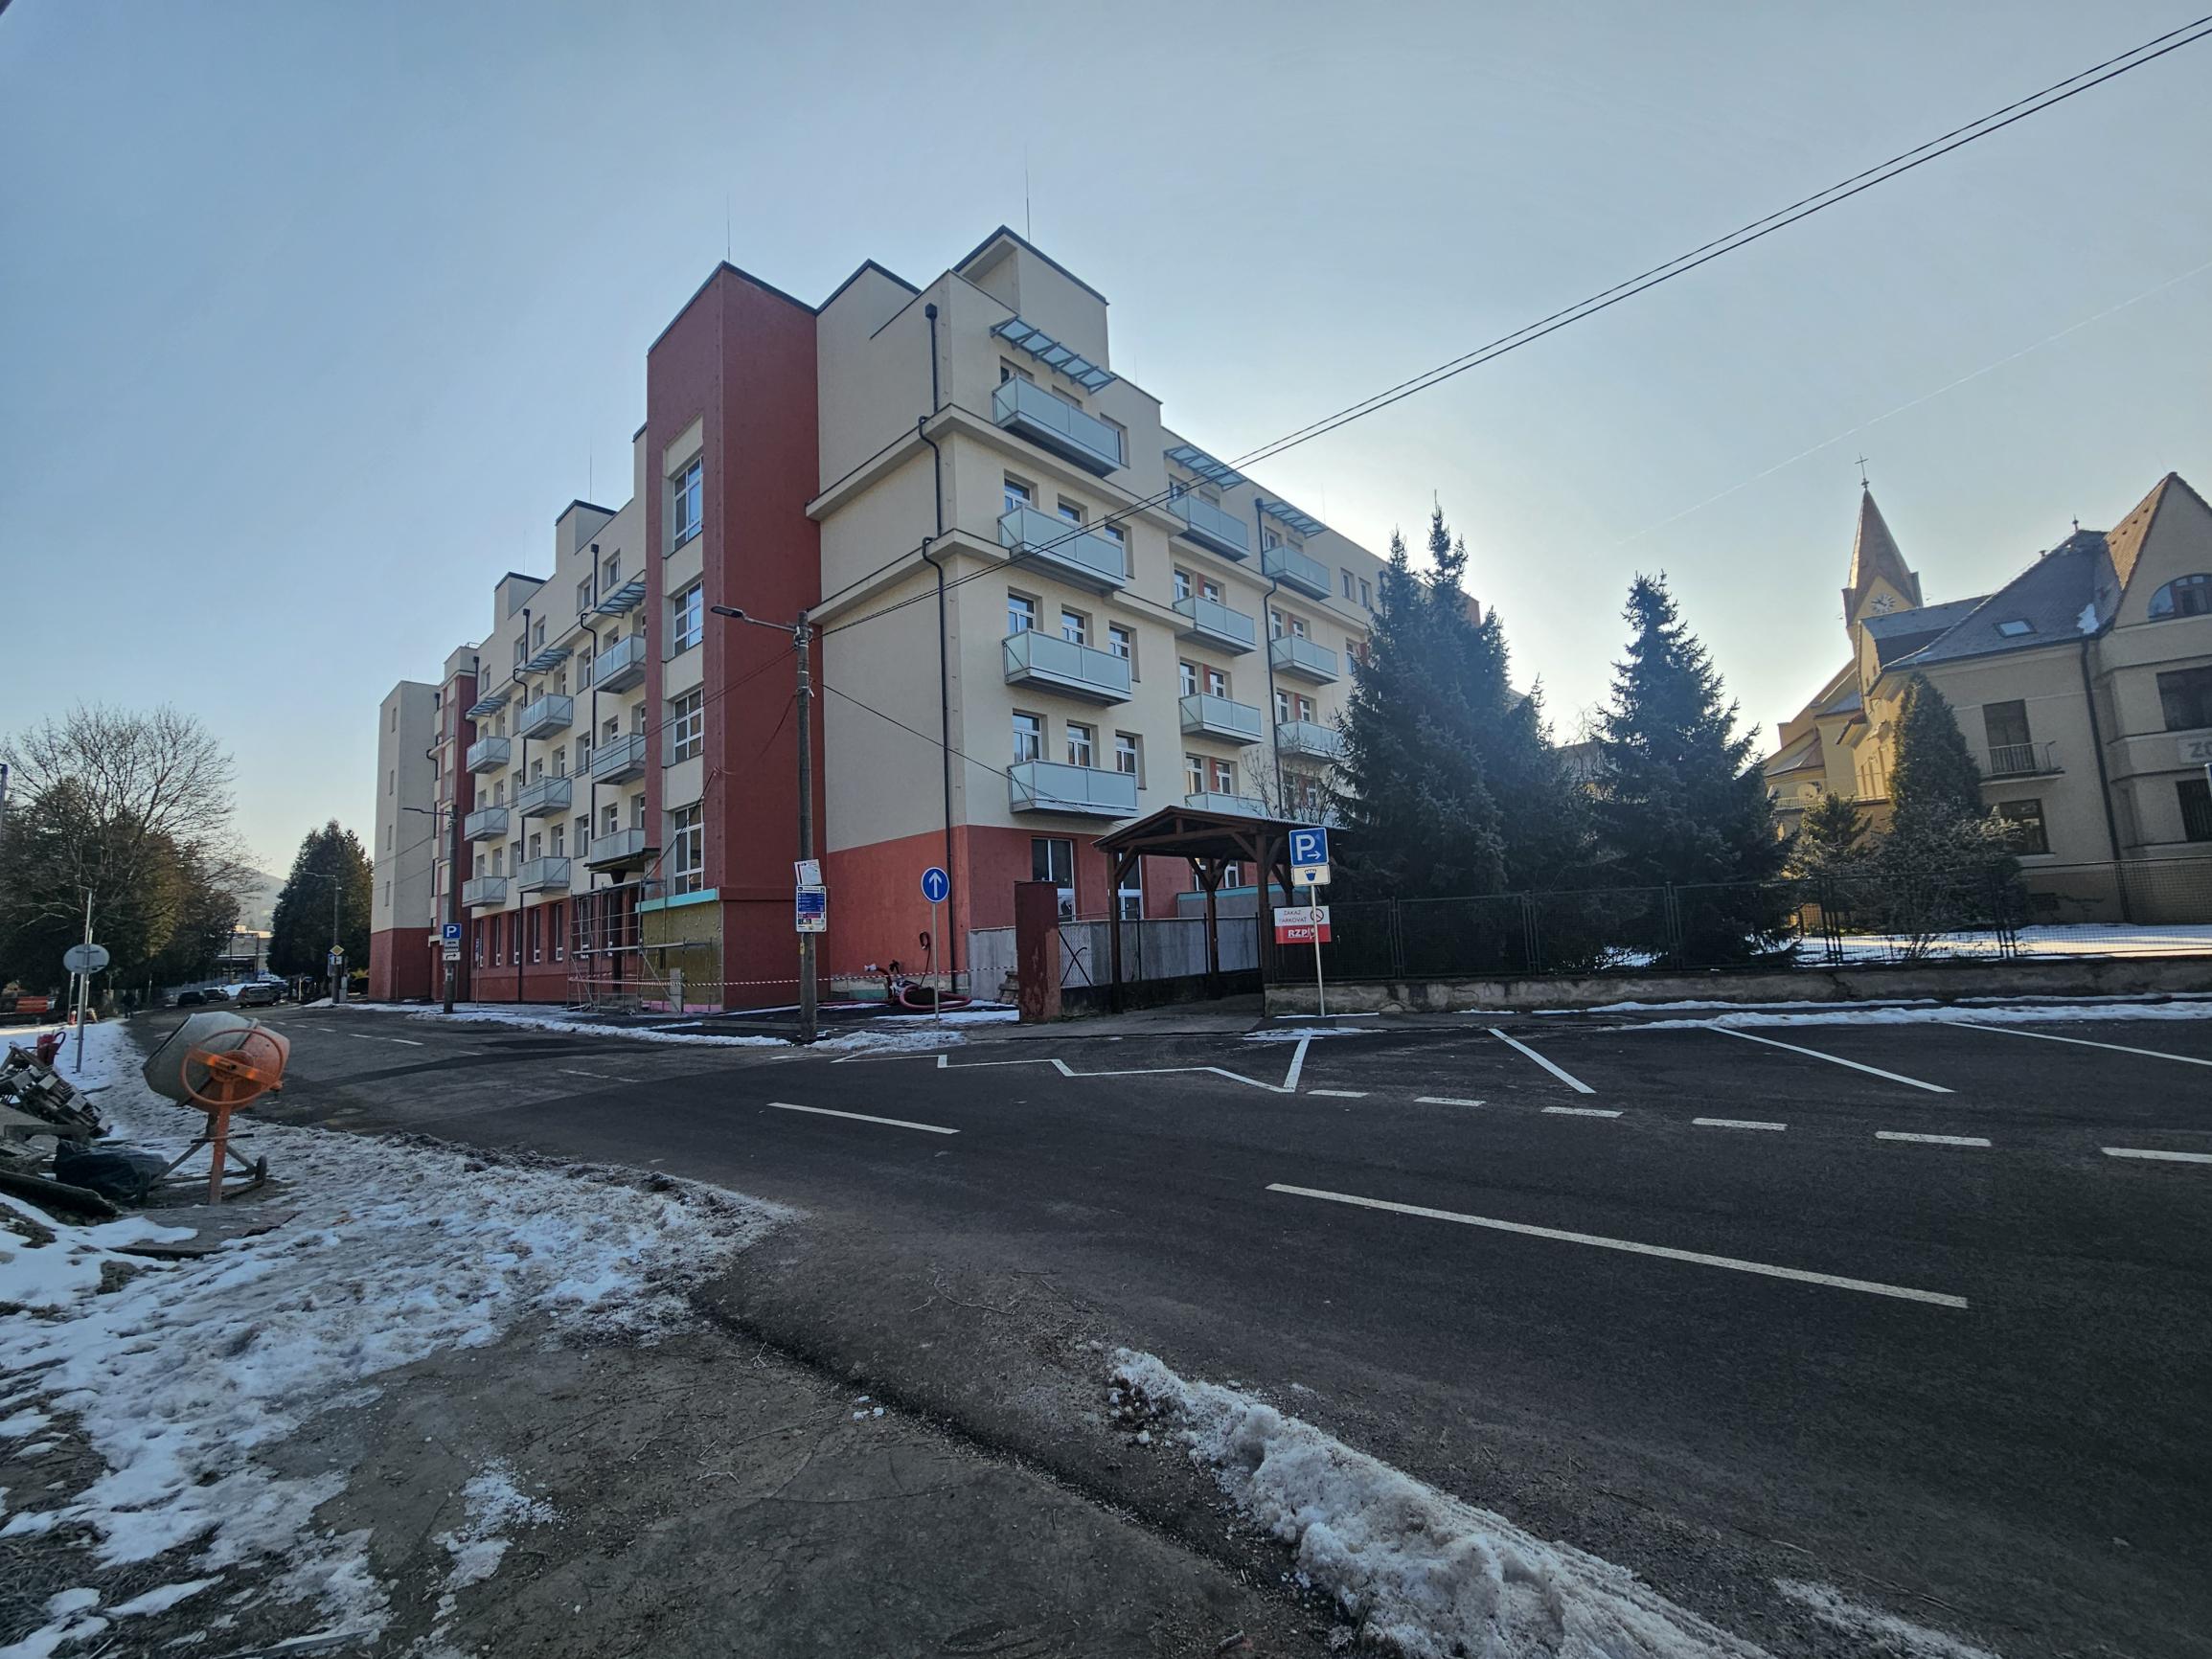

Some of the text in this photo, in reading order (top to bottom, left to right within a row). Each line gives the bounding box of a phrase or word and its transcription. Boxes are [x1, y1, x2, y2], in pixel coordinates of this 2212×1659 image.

[1295, 834, 1315, 861] P
[445, 925, 457, 938] P
[1288, 928, 1308, 938] RZP
